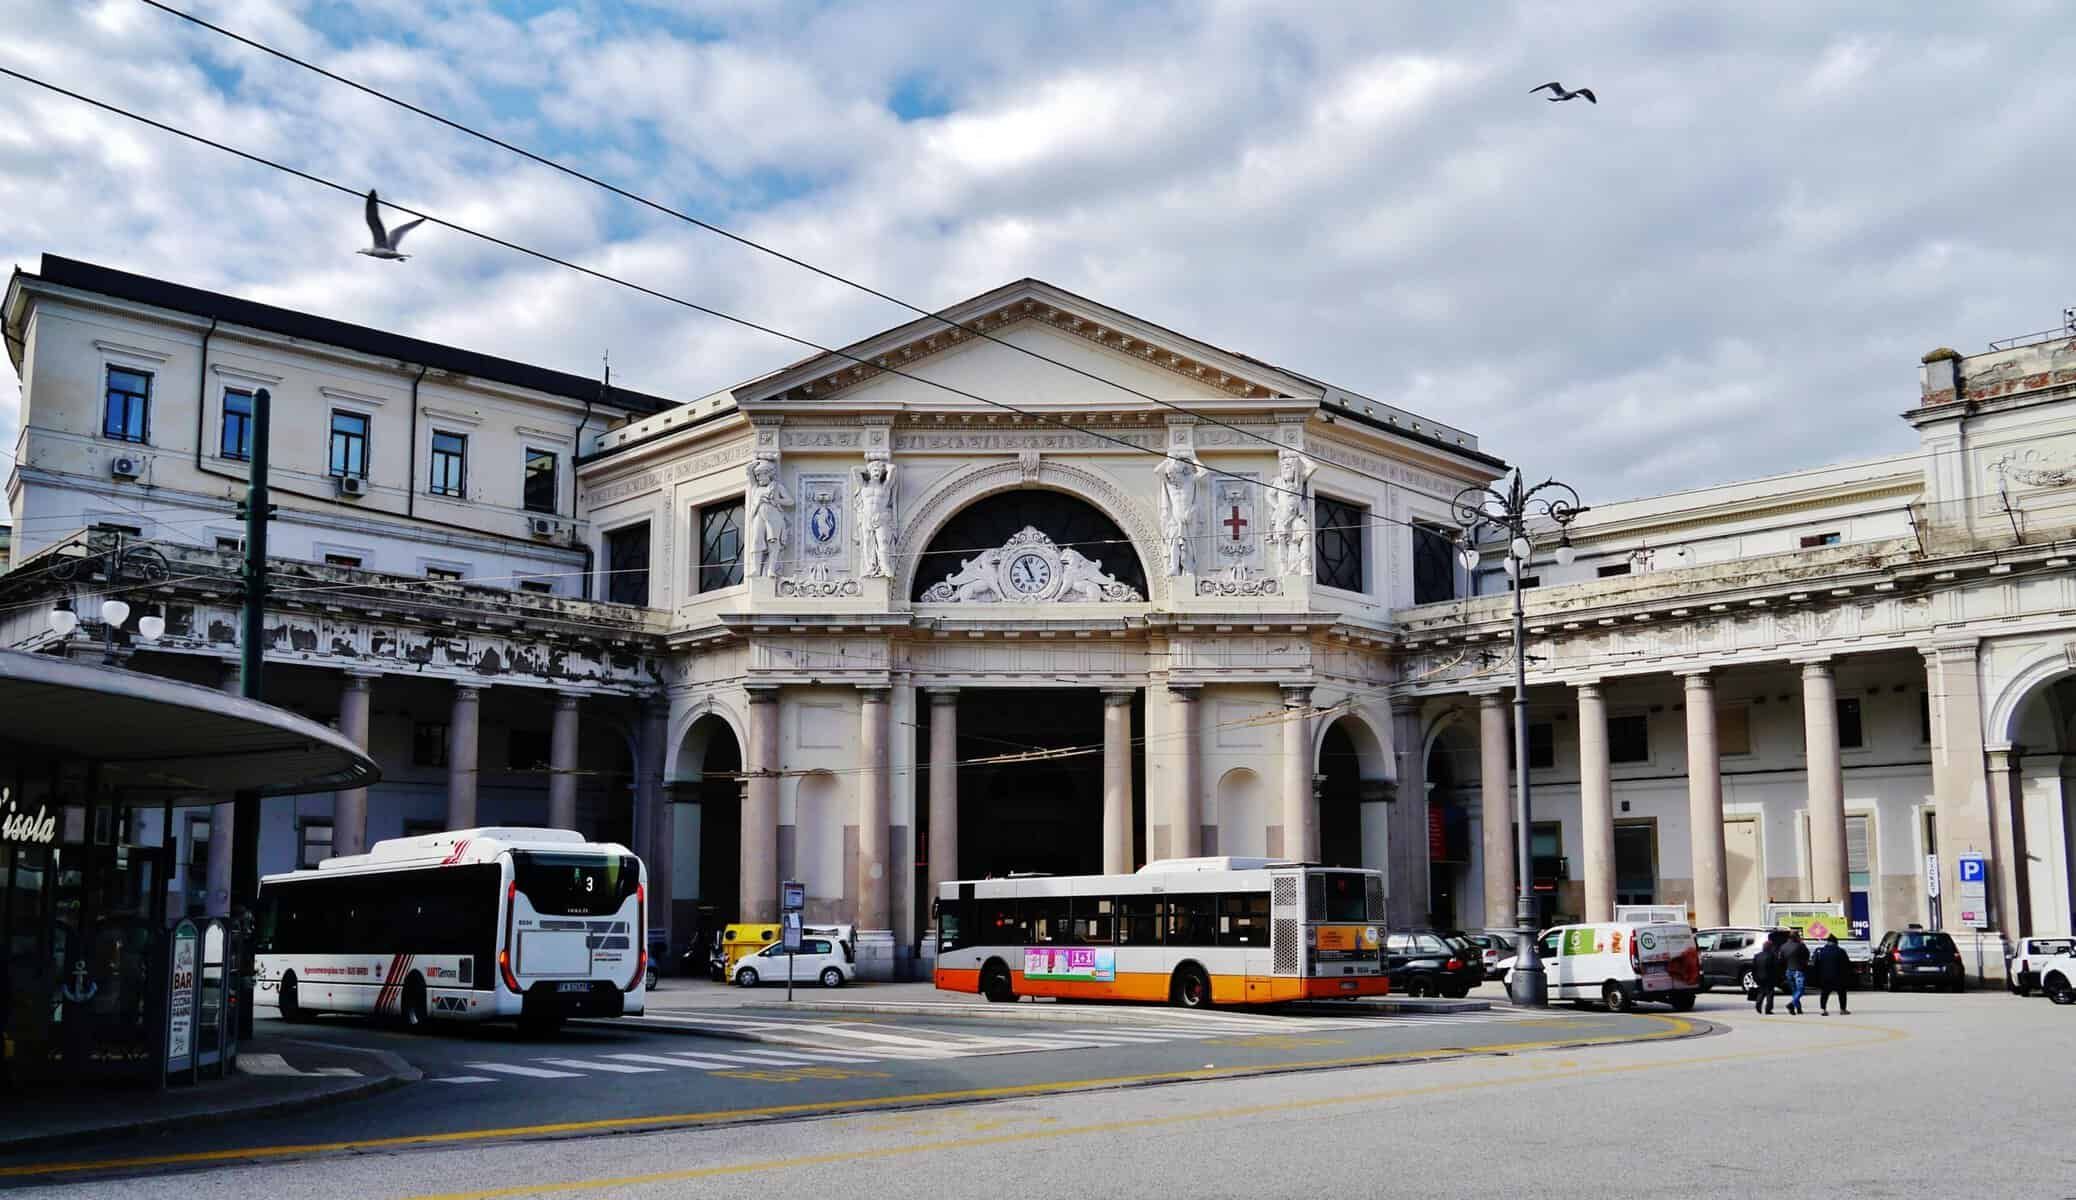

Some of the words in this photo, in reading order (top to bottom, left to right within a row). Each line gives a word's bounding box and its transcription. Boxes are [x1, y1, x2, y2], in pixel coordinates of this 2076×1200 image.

[0, 786, 56, 844] 'isola
[1963, 861, 1980, 881] P
[585, 876, 594, 892] 3
[174, 972, 193, 989] BAR
